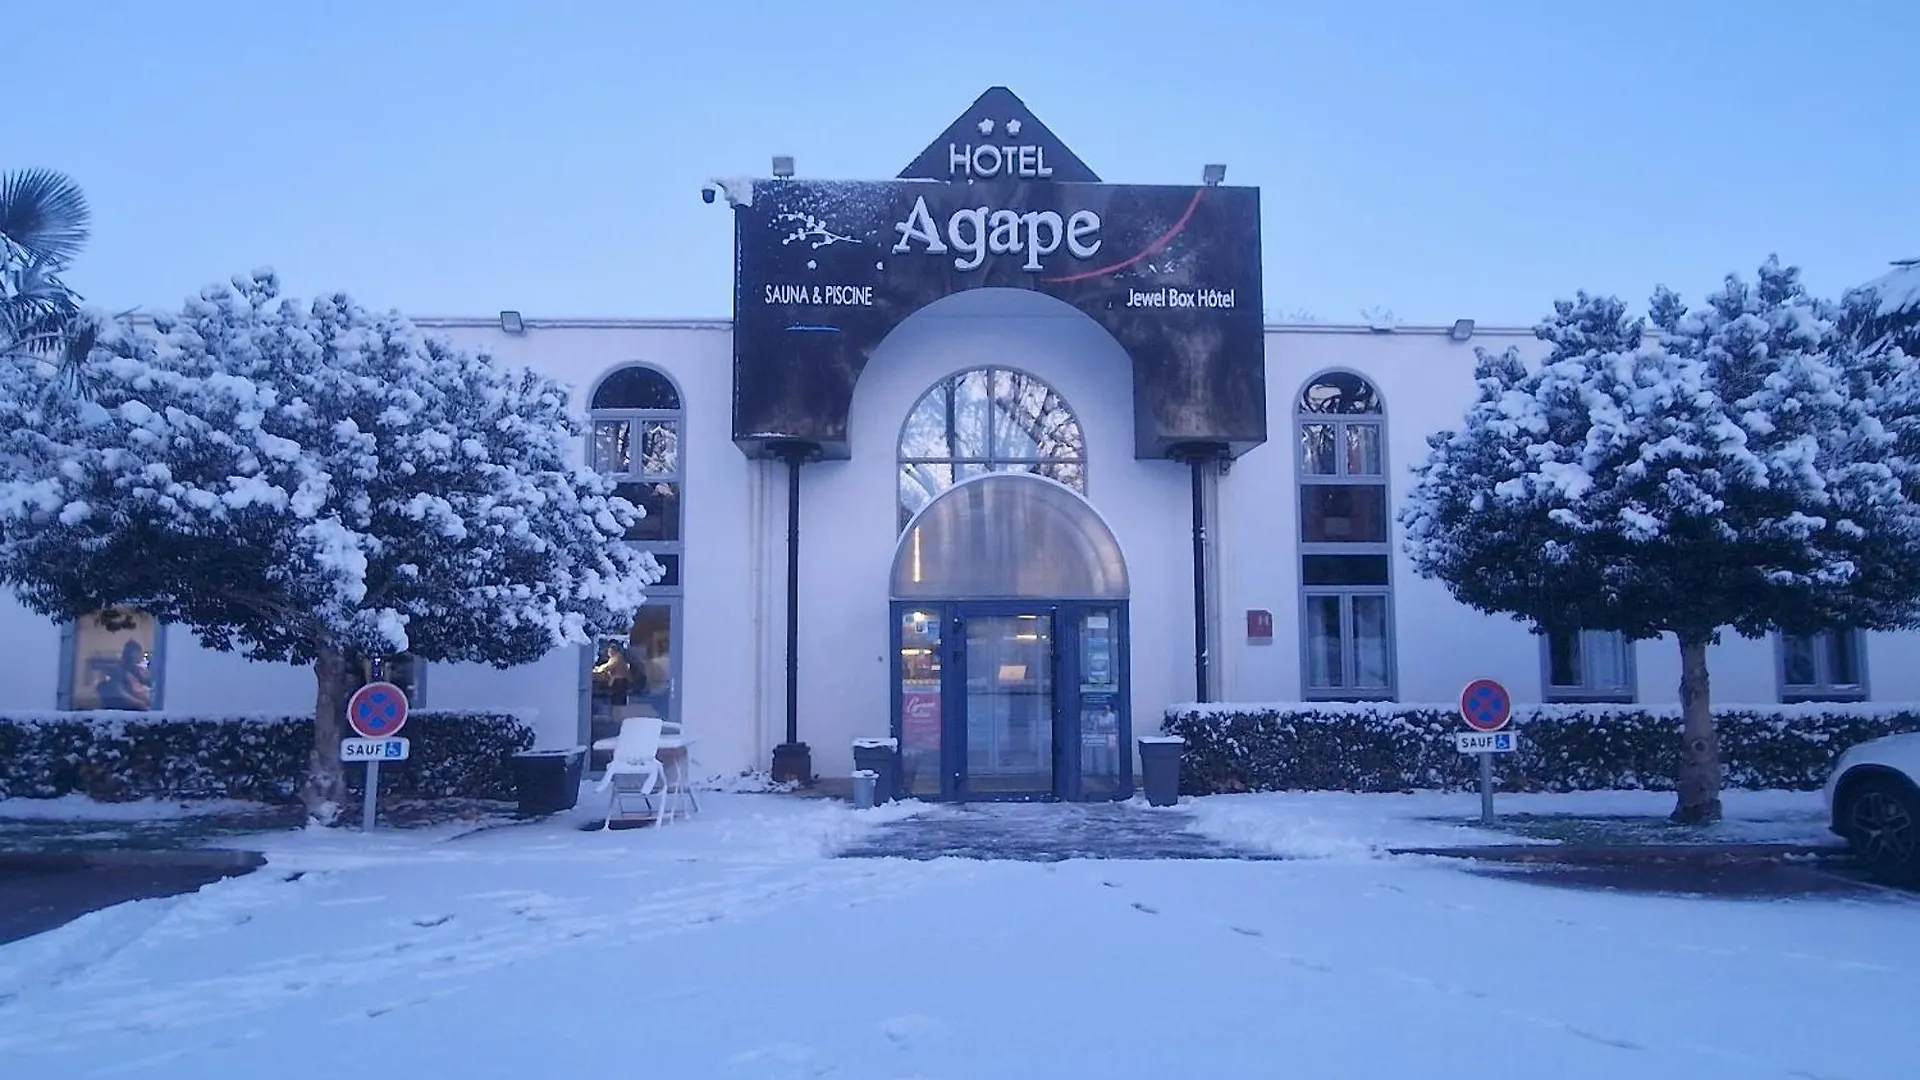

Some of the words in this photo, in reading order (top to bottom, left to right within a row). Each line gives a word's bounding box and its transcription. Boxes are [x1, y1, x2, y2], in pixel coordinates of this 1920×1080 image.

[949, 142, 1053, 177] HOTEL
[891, 195, 1102, 272] Agape
[764, 284, 809, 304] SAUNA
[812, 286, 822, 304] &
[825, 285, 873, 306] PISCINE
[1126, 287, 1166, 307] Jewel
[1169, 287, 1195, 307] Box
[1197, 288, 1235, 308] Hôtel
[346, 744, 382, 756] SAUF
[1462, 737, 1492, 748] SAUF
